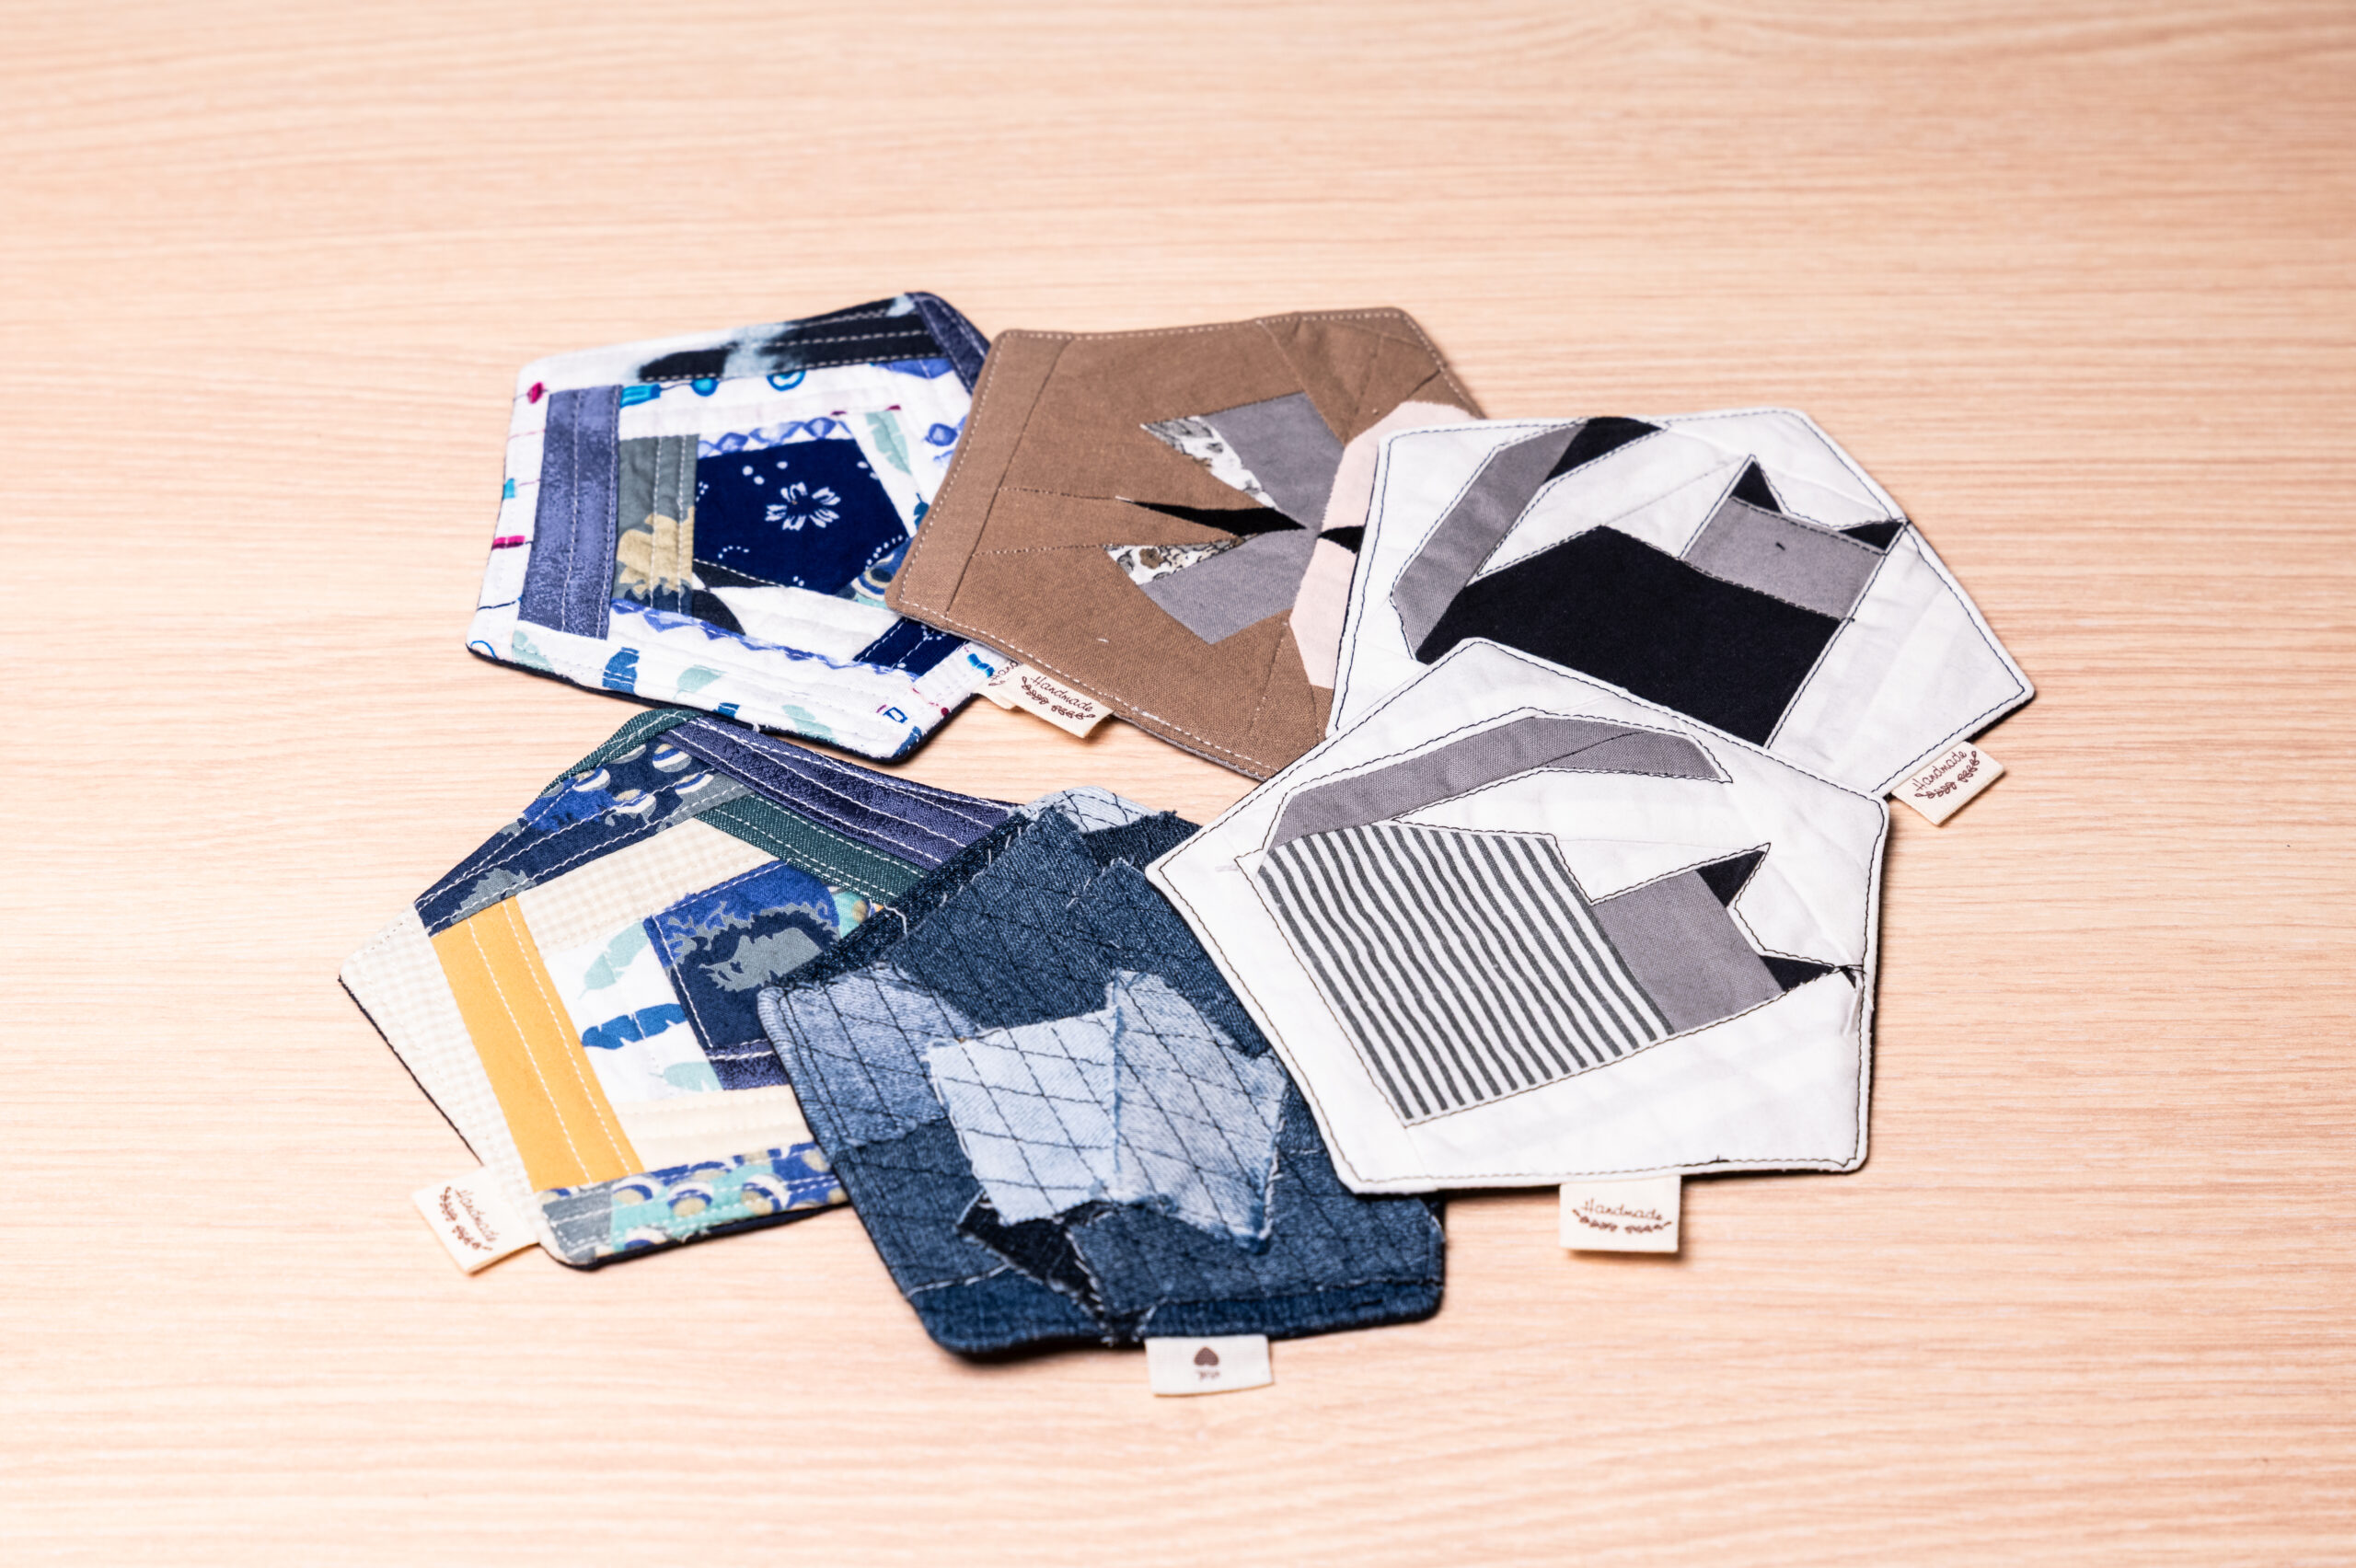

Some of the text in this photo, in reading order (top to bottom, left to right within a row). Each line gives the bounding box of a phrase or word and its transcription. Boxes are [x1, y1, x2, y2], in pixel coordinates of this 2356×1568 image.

[1030, 675, 1093, 712] Handmade
[1911, 750, 1968, 790] Handmade
[1581, 1197, 1663, 1220] Handmade
